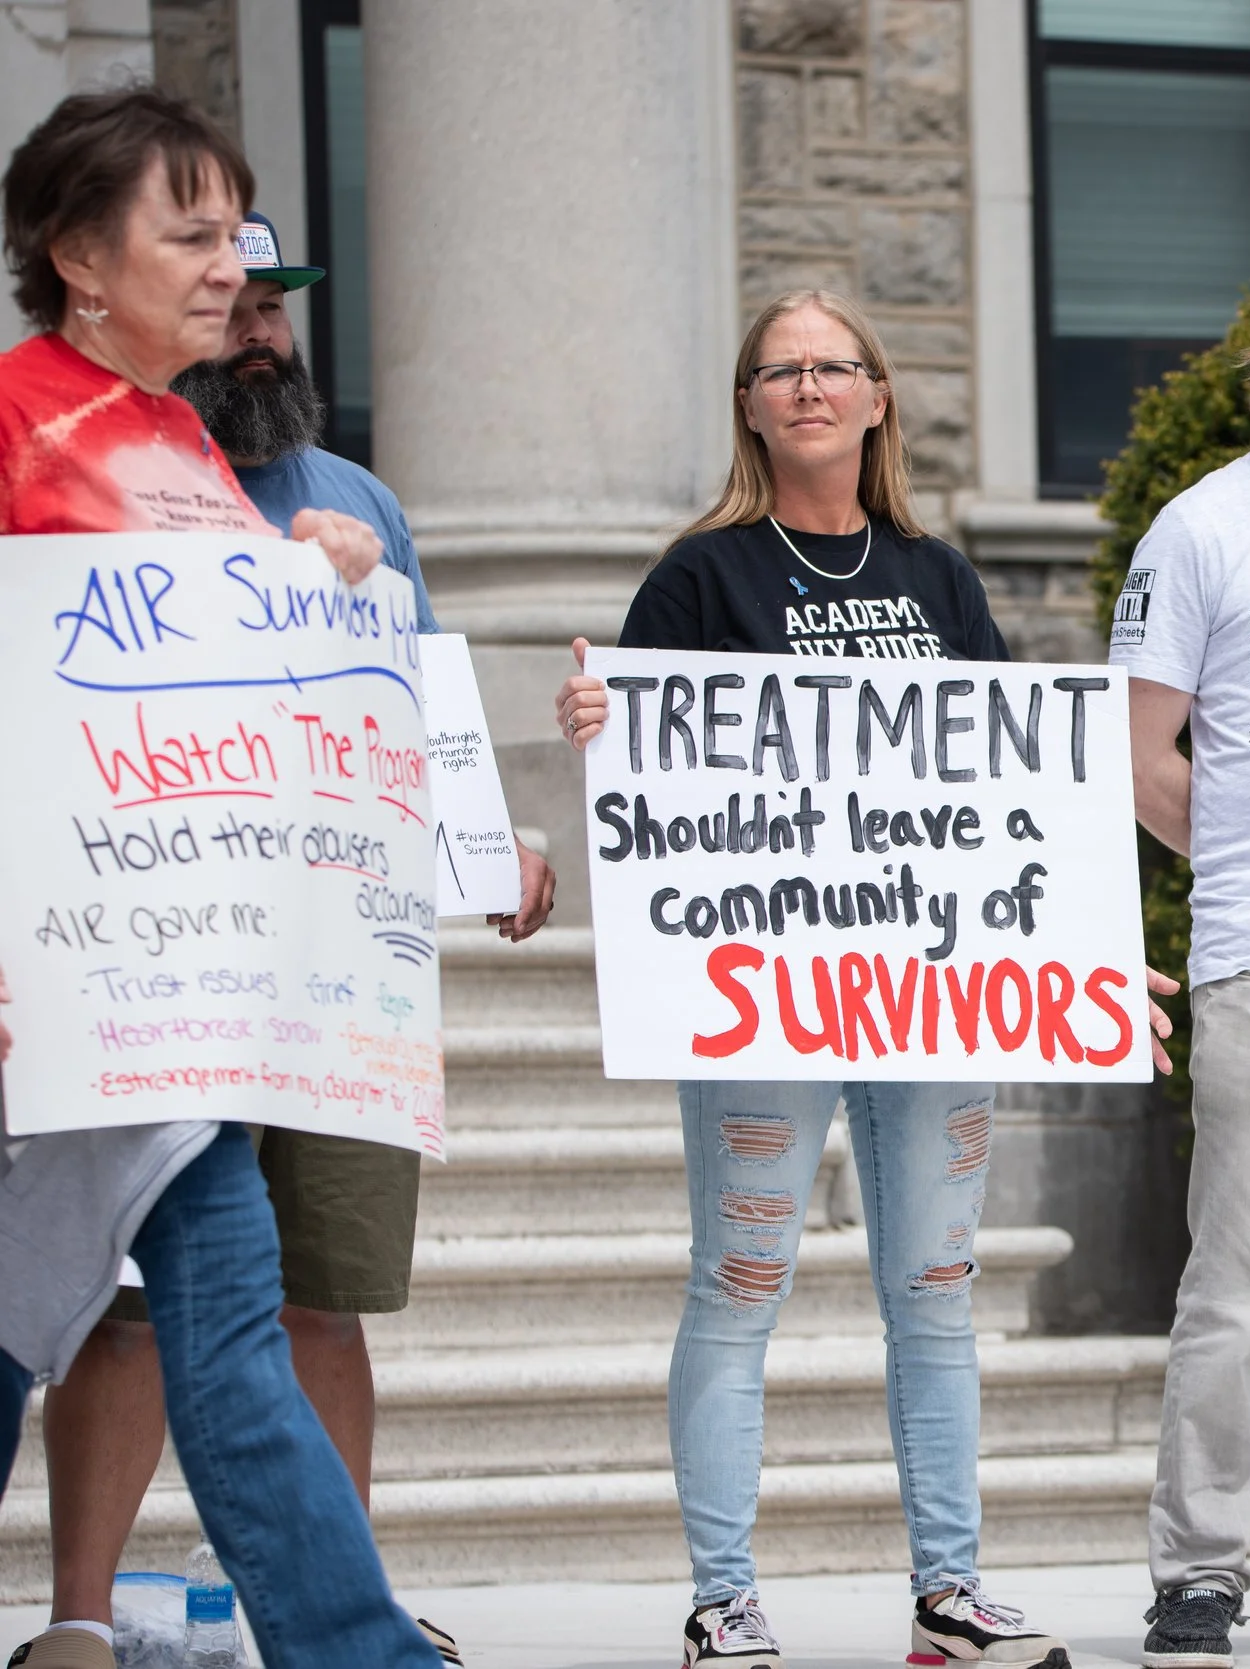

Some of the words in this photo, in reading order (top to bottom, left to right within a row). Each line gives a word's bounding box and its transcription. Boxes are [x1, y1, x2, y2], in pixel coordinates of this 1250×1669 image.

[237, 236, 273, 256] RIDGE
[54, 562, 198, 667] AIR
[789, 638, 847, 658] IVY
[855, 632, 949, 661] RIDGE
[80, 701, 279, 797] Watch
[438, 747, 479, 761] human
[605, 672, 1110, 784] TREATMENT
[442, 756, 478, 773] rights
[72, 815, 202, 877] Hold
[211, 811, 297, 861] their
[301, 821, 390, 878] abusers
[594, 786, 826, 862] Shouldn't
[846, 791, 986, 855] leave
[1005, 806, 1046, 844] a
[34, 902, 116, 952] AIR
[129, 902, 221, 957] gave
[649, 862, 958, 961] community
[980, 861, 1049, 936] of
[691, 942, 1134, 1067] SURVIVORS
